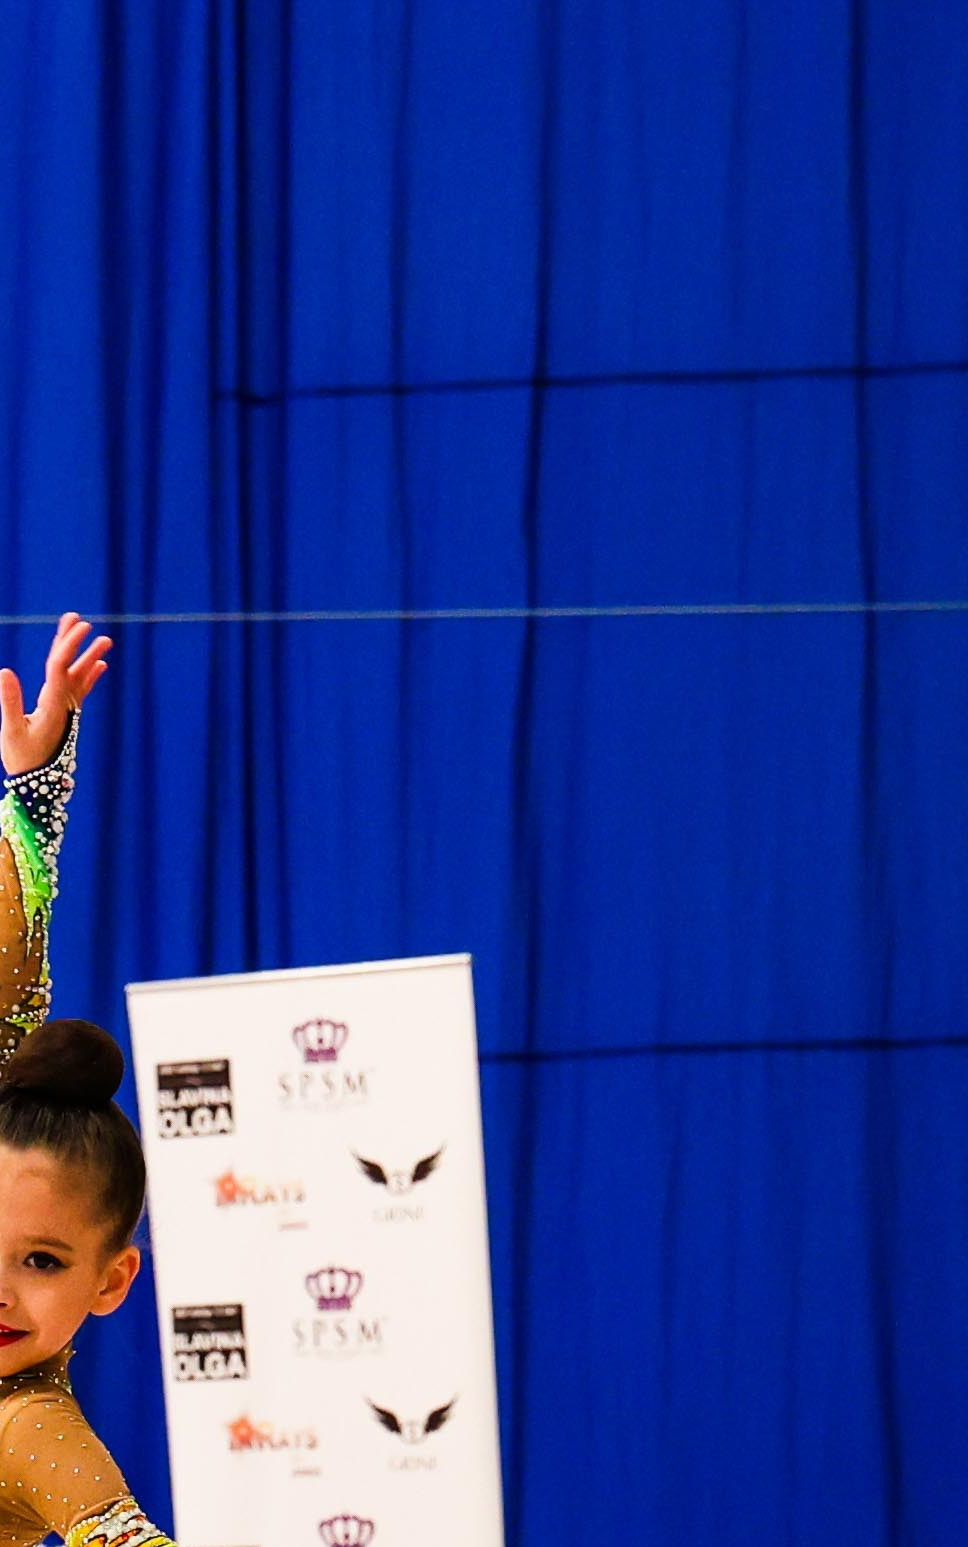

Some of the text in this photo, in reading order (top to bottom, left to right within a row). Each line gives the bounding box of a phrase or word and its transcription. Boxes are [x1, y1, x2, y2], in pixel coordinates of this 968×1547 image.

[279, 1071, 368, 1100] SPSM
[160, 1106, 232, 1137] OLGA
[293, 1318, 382, 1348] SPSM
[175, 1351, 247, 1381] OLGA
